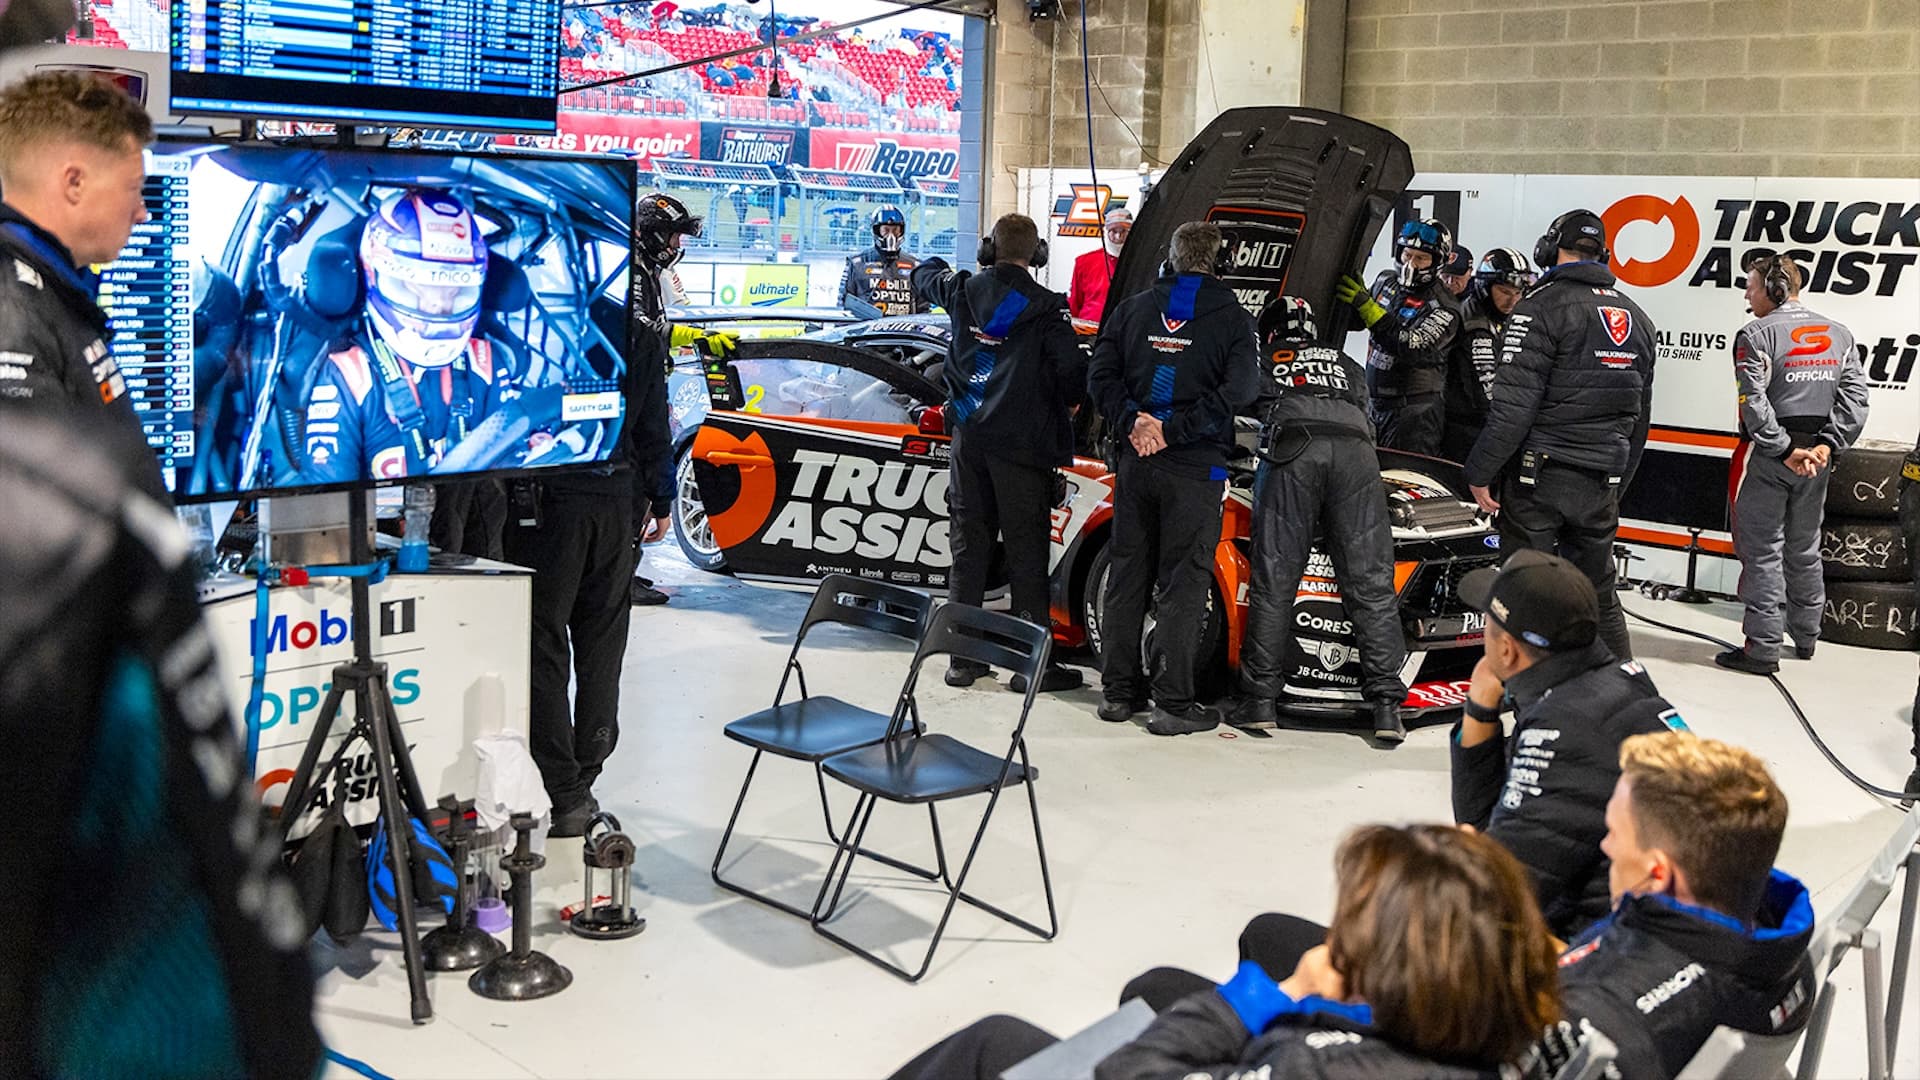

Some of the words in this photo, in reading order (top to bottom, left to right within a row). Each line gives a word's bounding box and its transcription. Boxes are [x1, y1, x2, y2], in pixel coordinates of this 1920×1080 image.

[723, 140, 789, 165] BATHURST
[872, 138, 959, 178] Repco
[1714, 199, 1920, 247] TRUCK
[749, 283, 799, 295] ultimate
[872, 291, 911, 302] OPTUS
[1236, 289, 1270, 305] UCK
[1656, 330, 1675, 346] AL
[1680, 332, 1726, 349] GUYS
[1672, 348, 1704, 360] SHINE
[1273, 362, 1346, 378] OPTUS
[1785, 370, 1836, 383] OFFICIAL
[1275, 373, 1329, 388] Mobil
[743, 384, 765, 413] 2
[791, 449, 952, 517] TRUC
[761, 500, 954, 568] ASSIS
[1298, 580, 1338, 593] EARW
[1461, 611, 1487, 634] PAL
[1297, 666, 1310, 676] JB
[1311, 668, 1359, 686] Caravans
